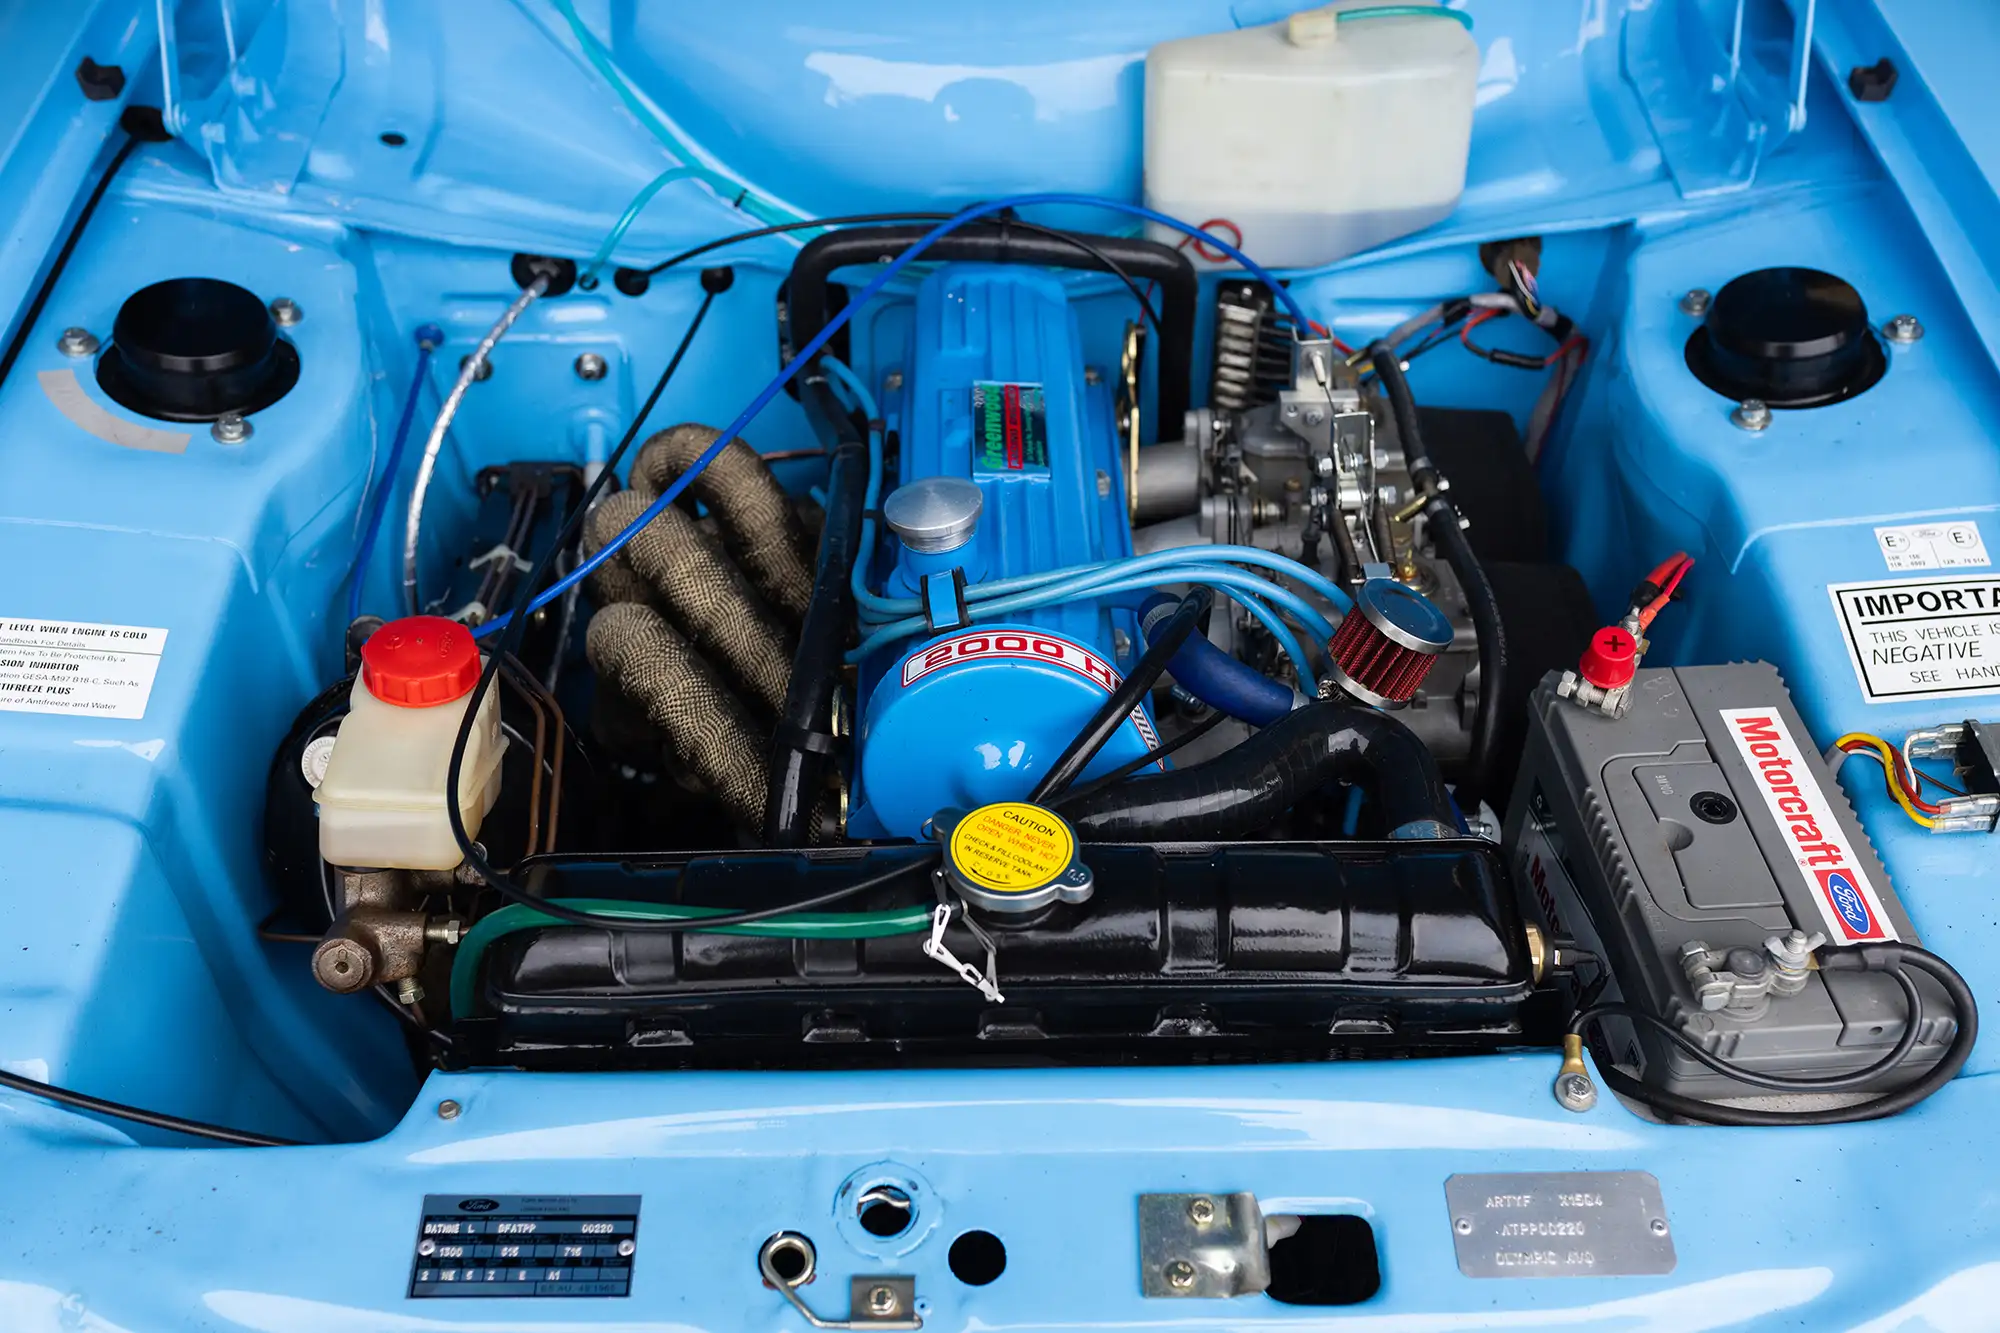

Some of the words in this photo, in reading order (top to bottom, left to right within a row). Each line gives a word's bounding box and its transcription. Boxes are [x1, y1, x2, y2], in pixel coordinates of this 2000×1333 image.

[981, 384, 1003, 469] Greenwood
[1885, 536, 1897, 547] E
[1953, 532, 1965, 543] E
[9, 623, 35, 632] LEVEL
[40, 625, 69, 634] WHEN
[72, 627, 107, 637] ENGINE
[110, 630, 120, 638] IS
[123, 631, 148, 640] COLD
[1869, 629, 1908, 645] THIS
[1915, 623, 1983, 642] VEHICLE
[57, 640, 86, 648] Details
[924, 636, 1064, 668] 2000
[1873, 640, 1982, 666] NEGATIVE
[19, 649, 35, 657] Has
[63, 652, 105, 661] Protected
[107, 655, 119, 663] By
[29, 660, 80, 671] INHIBITOR
[103, 678, 126, 686] Such
[1909, 669, 1942, 684] SEE
[25, 698, 70, 707] Antifreeze
[72, 701, 89, 709] and
[91, 702, 117, 710] Water
[1735, 717, 1844, 867] Motorcraft
[983, 815, 1022, 836] DANGER
[1024, 833, 1056, 850] NEVER
[1003, 810, 1056, 837] CAUTION
[963, 833, 989, 848] CHECK
[997, 847, 1012, 858] FILL
[1012, 854, 1050, 873] COOLANT
[976, 823, 1003, 838] OPEN
[1008, 836, 1034, 853] WHEN
[1038, 850, 1060, 862] HOT
[964, 844, 972, 852] IN
[973, 848, 1008, 869] RESERVE
[1011, 865, 1032, 878] TANK
[1833, 884, 1863, 923] Ford
[467, 1222, 475, 1234] L
